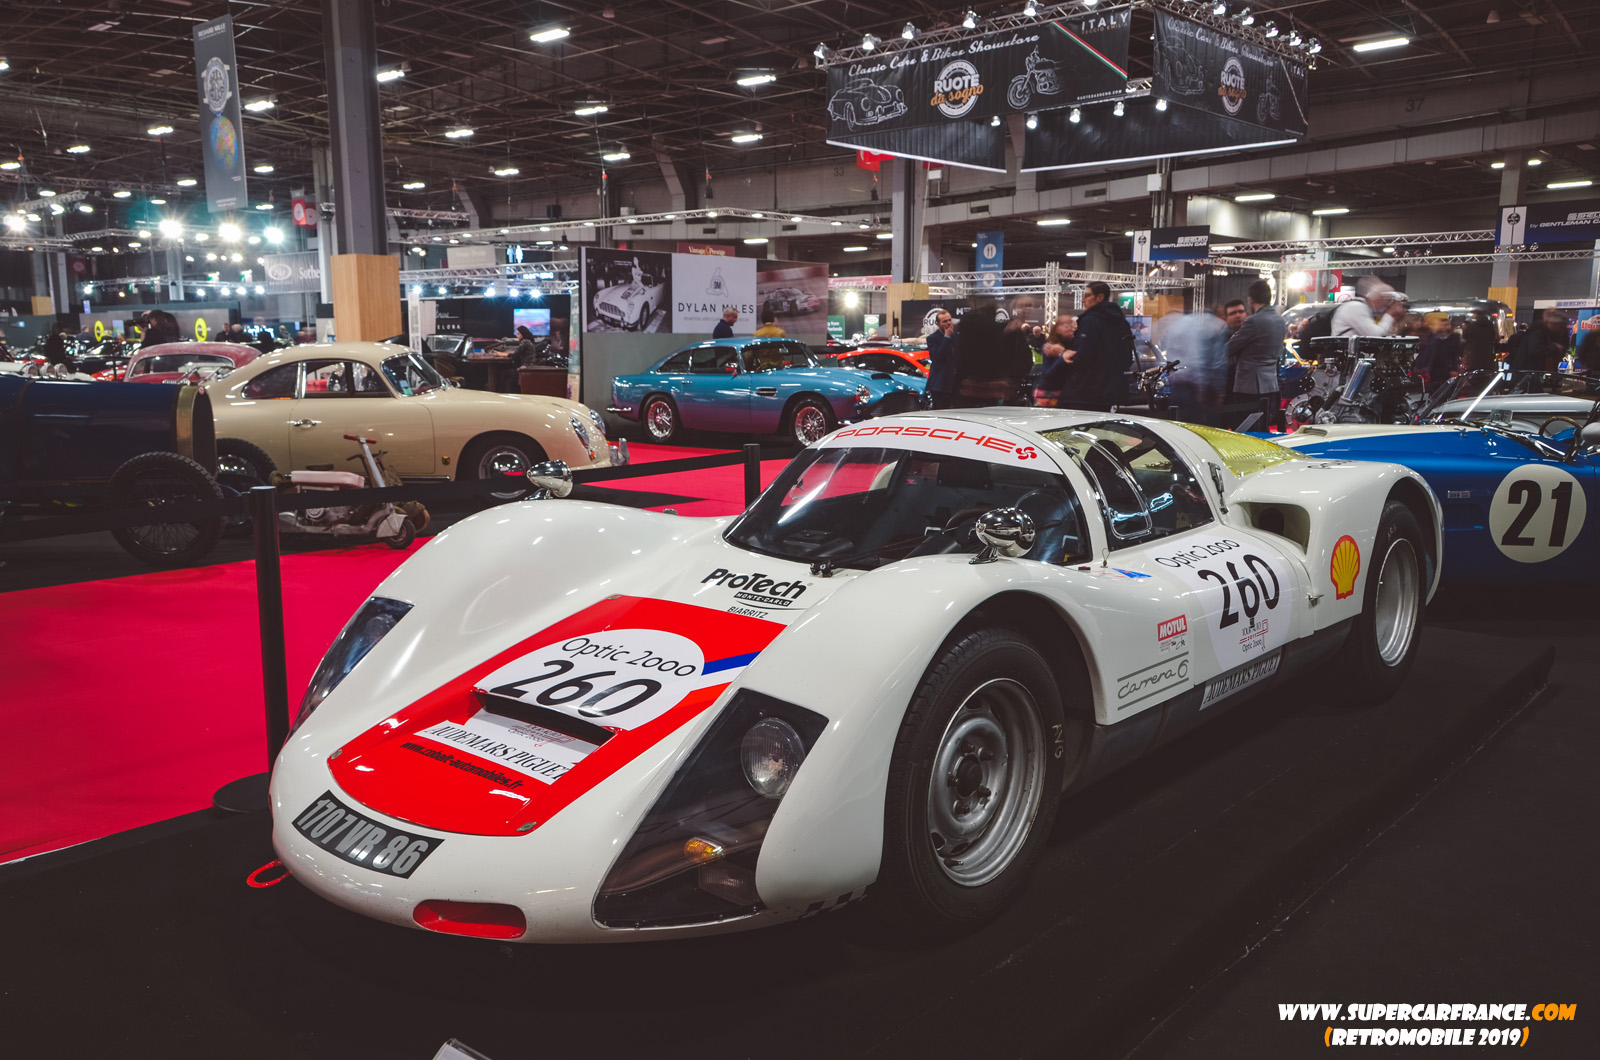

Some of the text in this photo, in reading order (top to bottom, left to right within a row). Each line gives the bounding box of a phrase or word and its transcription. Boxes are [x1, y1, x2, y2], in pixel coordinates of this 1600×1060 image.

[1081, 12, 1129, 31] ITALY
[848, 33, 1041, 77] Classic Cars & Bikes Showstore
[930, 84, 985, 106] da sogno
[934, 73, 980, 93] RUOTE
[1221, 70, 1246, 90] RUOTE
[1405, 98, 1425, 113] 37
[833, 167, 845, 177] 33
[1539, 219, 1591, 228] GENTLEMAN
[677, 302, 717, 313] DYLAN
[832, 426, 1017, 453] PORSCHE
[1501, 479, 1573, 547] 21
[1154, 539, 1241, 569] Optic 2000
[700, 568, 807, 600] ProTech
[1197, 554, 1280, 630] 260
[727, 605, 769, 619] BIARRITZ
[1159, 617, 1186, 639] MOTUL
[562, 637, 697, 677] Optic 2000
[489, 659, 663, 718] 260
[1117, 659, 1189, 699] Carrera 6
[1203, 653, 1281, 705] AUDEMARS PIGUET
[424, 726, 517, 759] AUDEMARS
[400, 741, 525, 791] www.cobalt-automobiles.fr
[297, 799, 429, 875] 1707 VR 86
